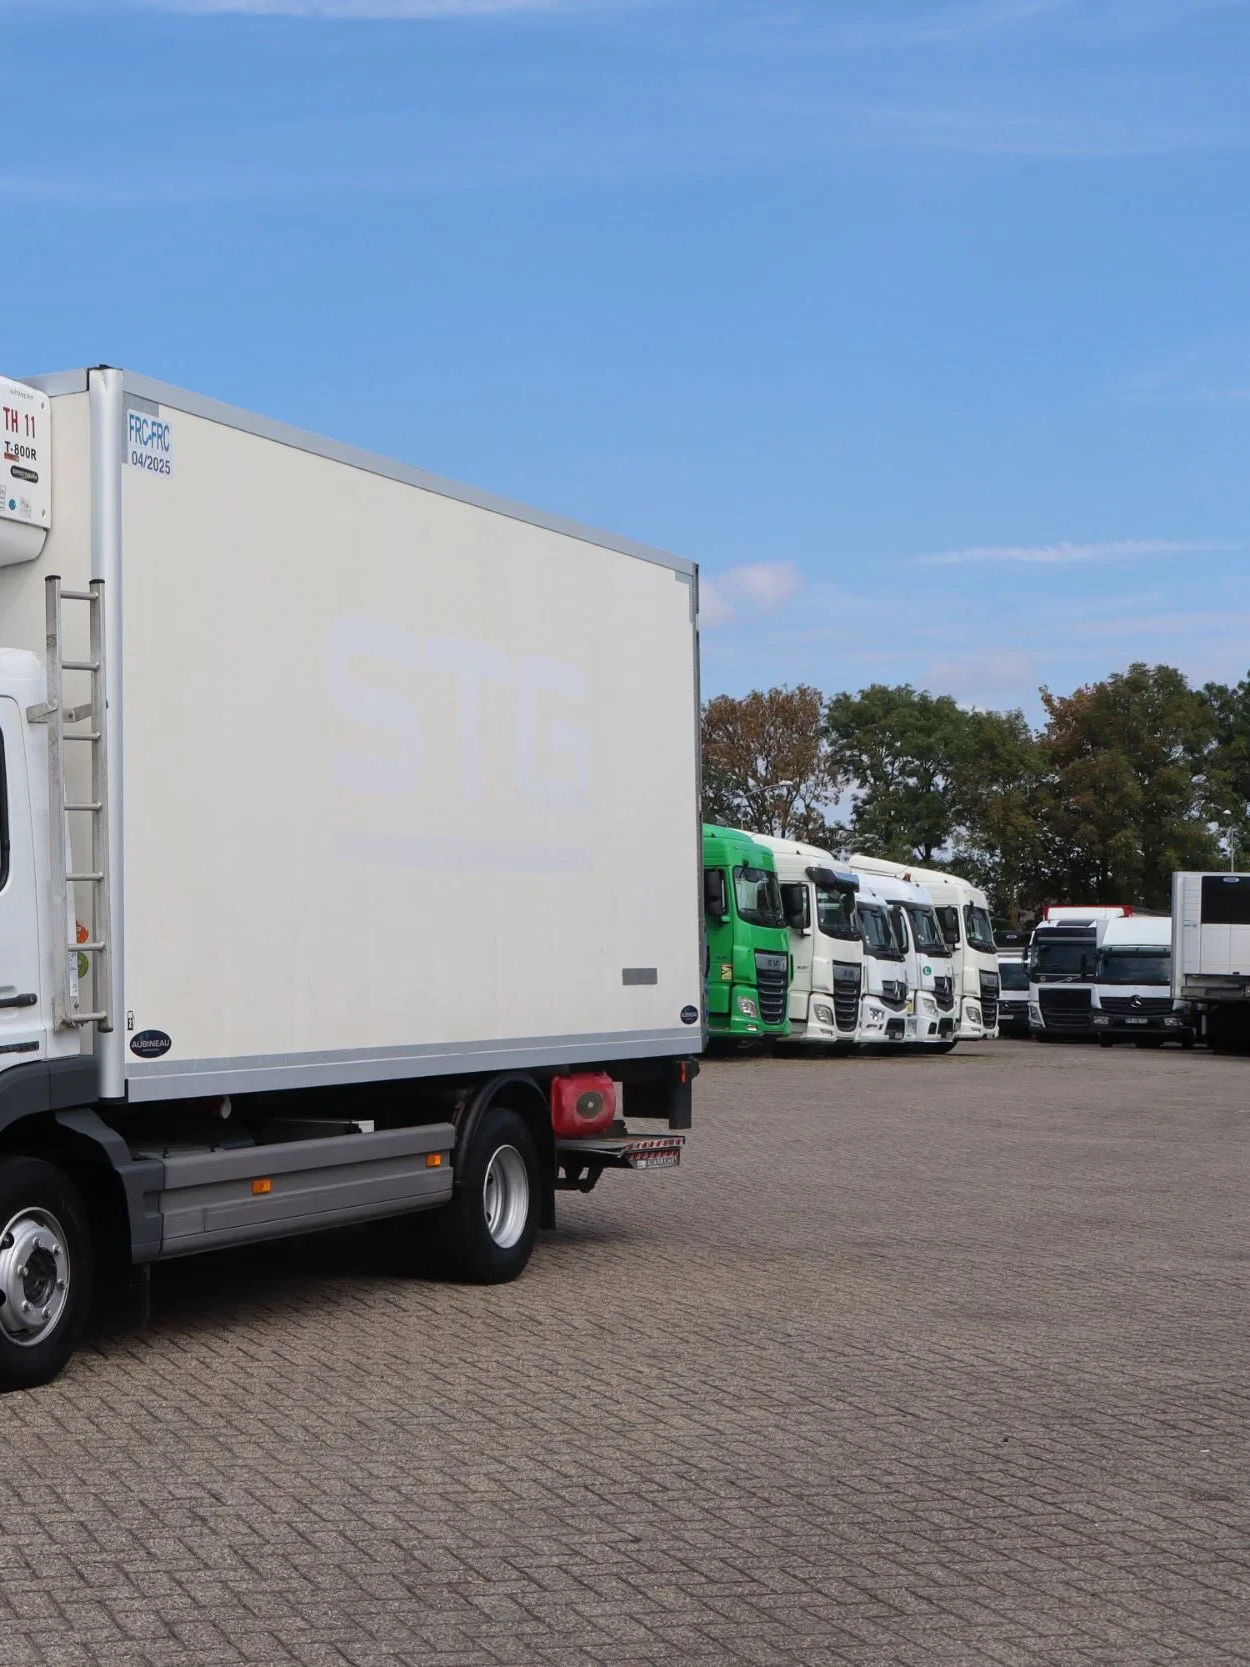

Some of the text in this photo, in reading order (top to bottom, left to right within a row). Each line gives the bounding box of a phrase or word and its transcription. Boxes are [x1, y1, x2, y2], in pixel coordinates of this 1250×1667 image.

[3, 406, 35, 439] TH 11
[129, 414, 170, 452] FRC-FRC
[4, 440, 37, 461] T-800R
[131, 450, 171, 475] 04/2025
[326, 613, 592, 812] STG
